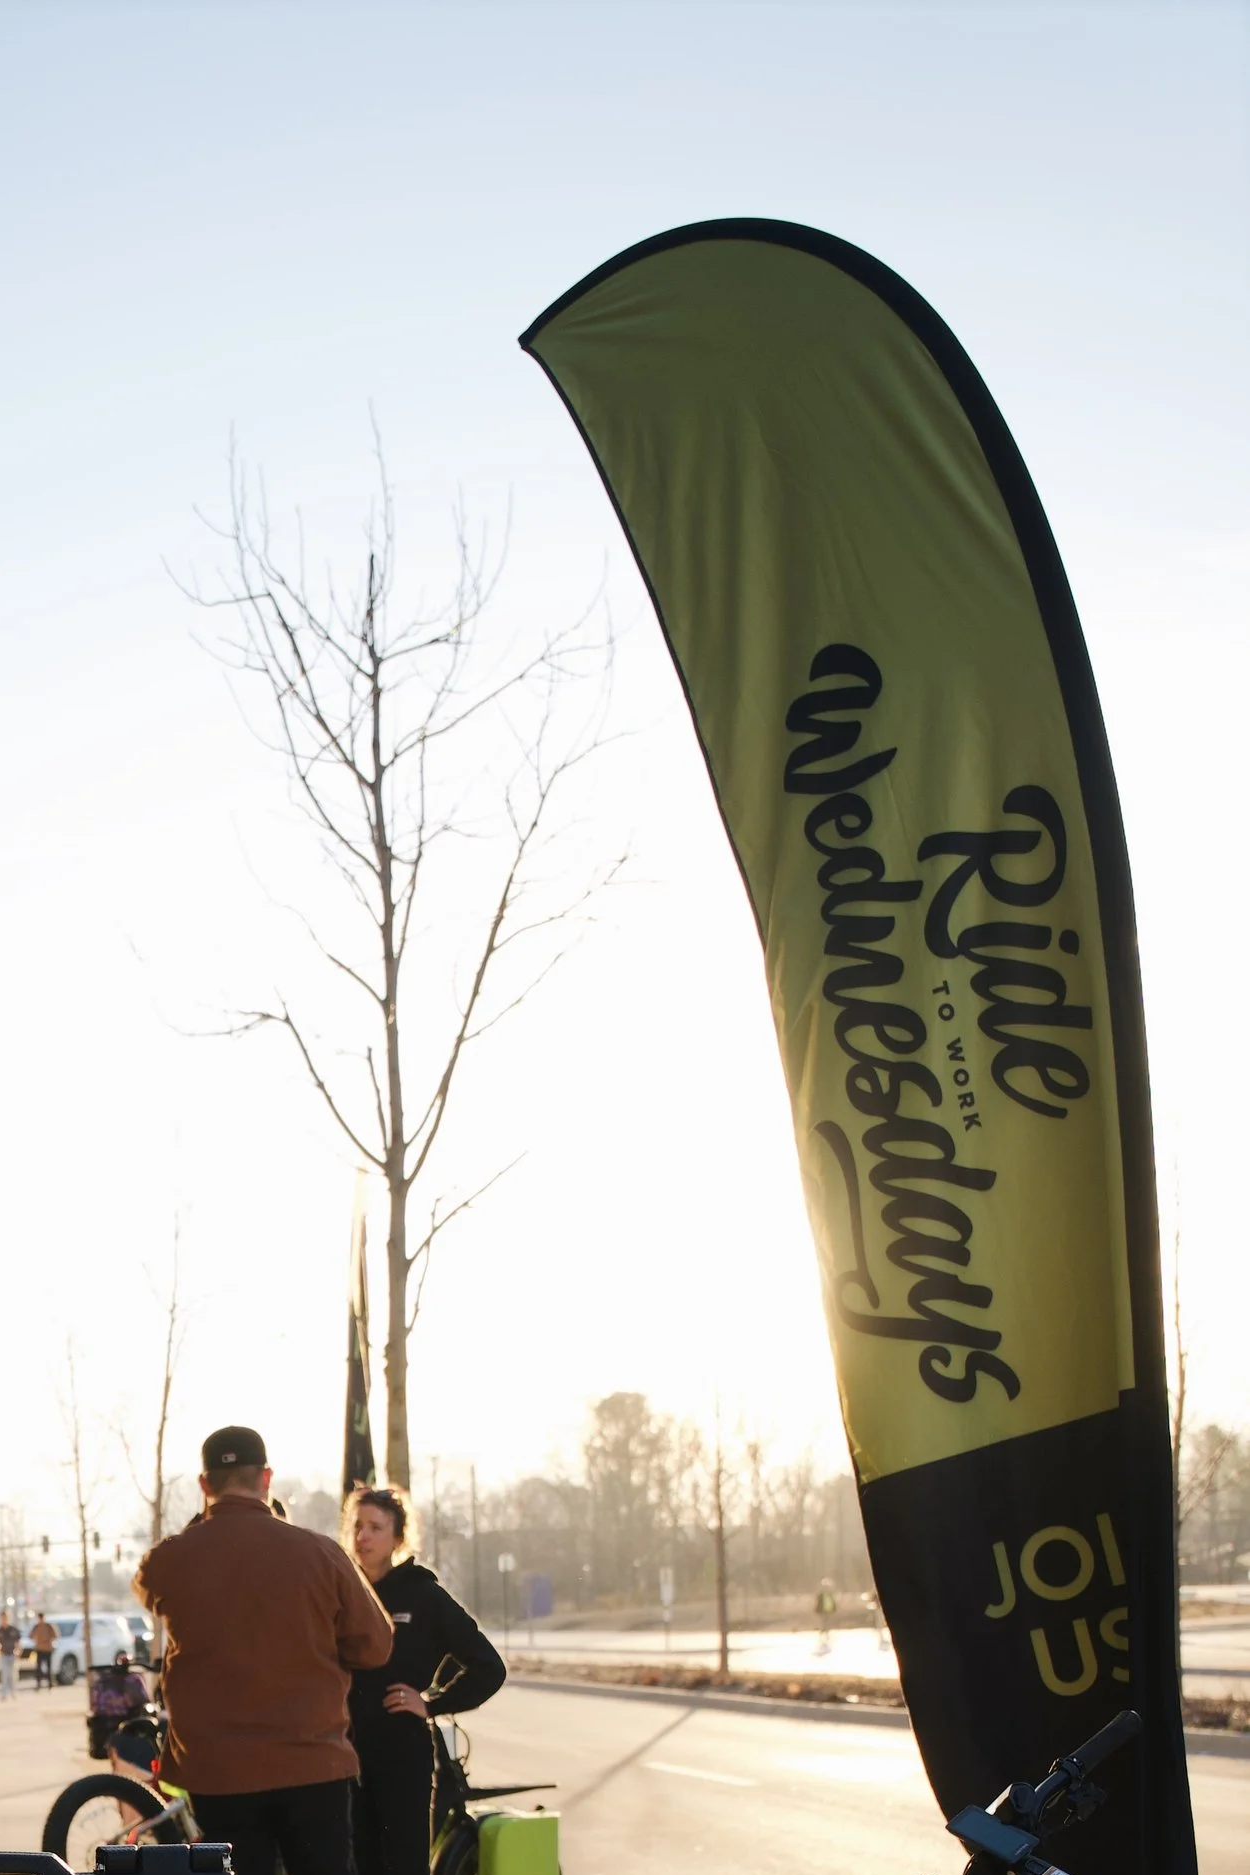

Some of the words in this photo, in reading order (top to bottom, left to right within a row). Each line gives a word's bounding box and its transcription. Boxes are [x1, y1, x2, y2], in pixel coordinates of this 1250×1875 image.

[784, 643, 1021, 1403] Wednesdays
[917, 784, 1094, 1120] Ride
[932, 980, 955, 1021] TO
[946, 1036, 982, 1132] WORK
[984, 1512, 1126, 1619] JOI
